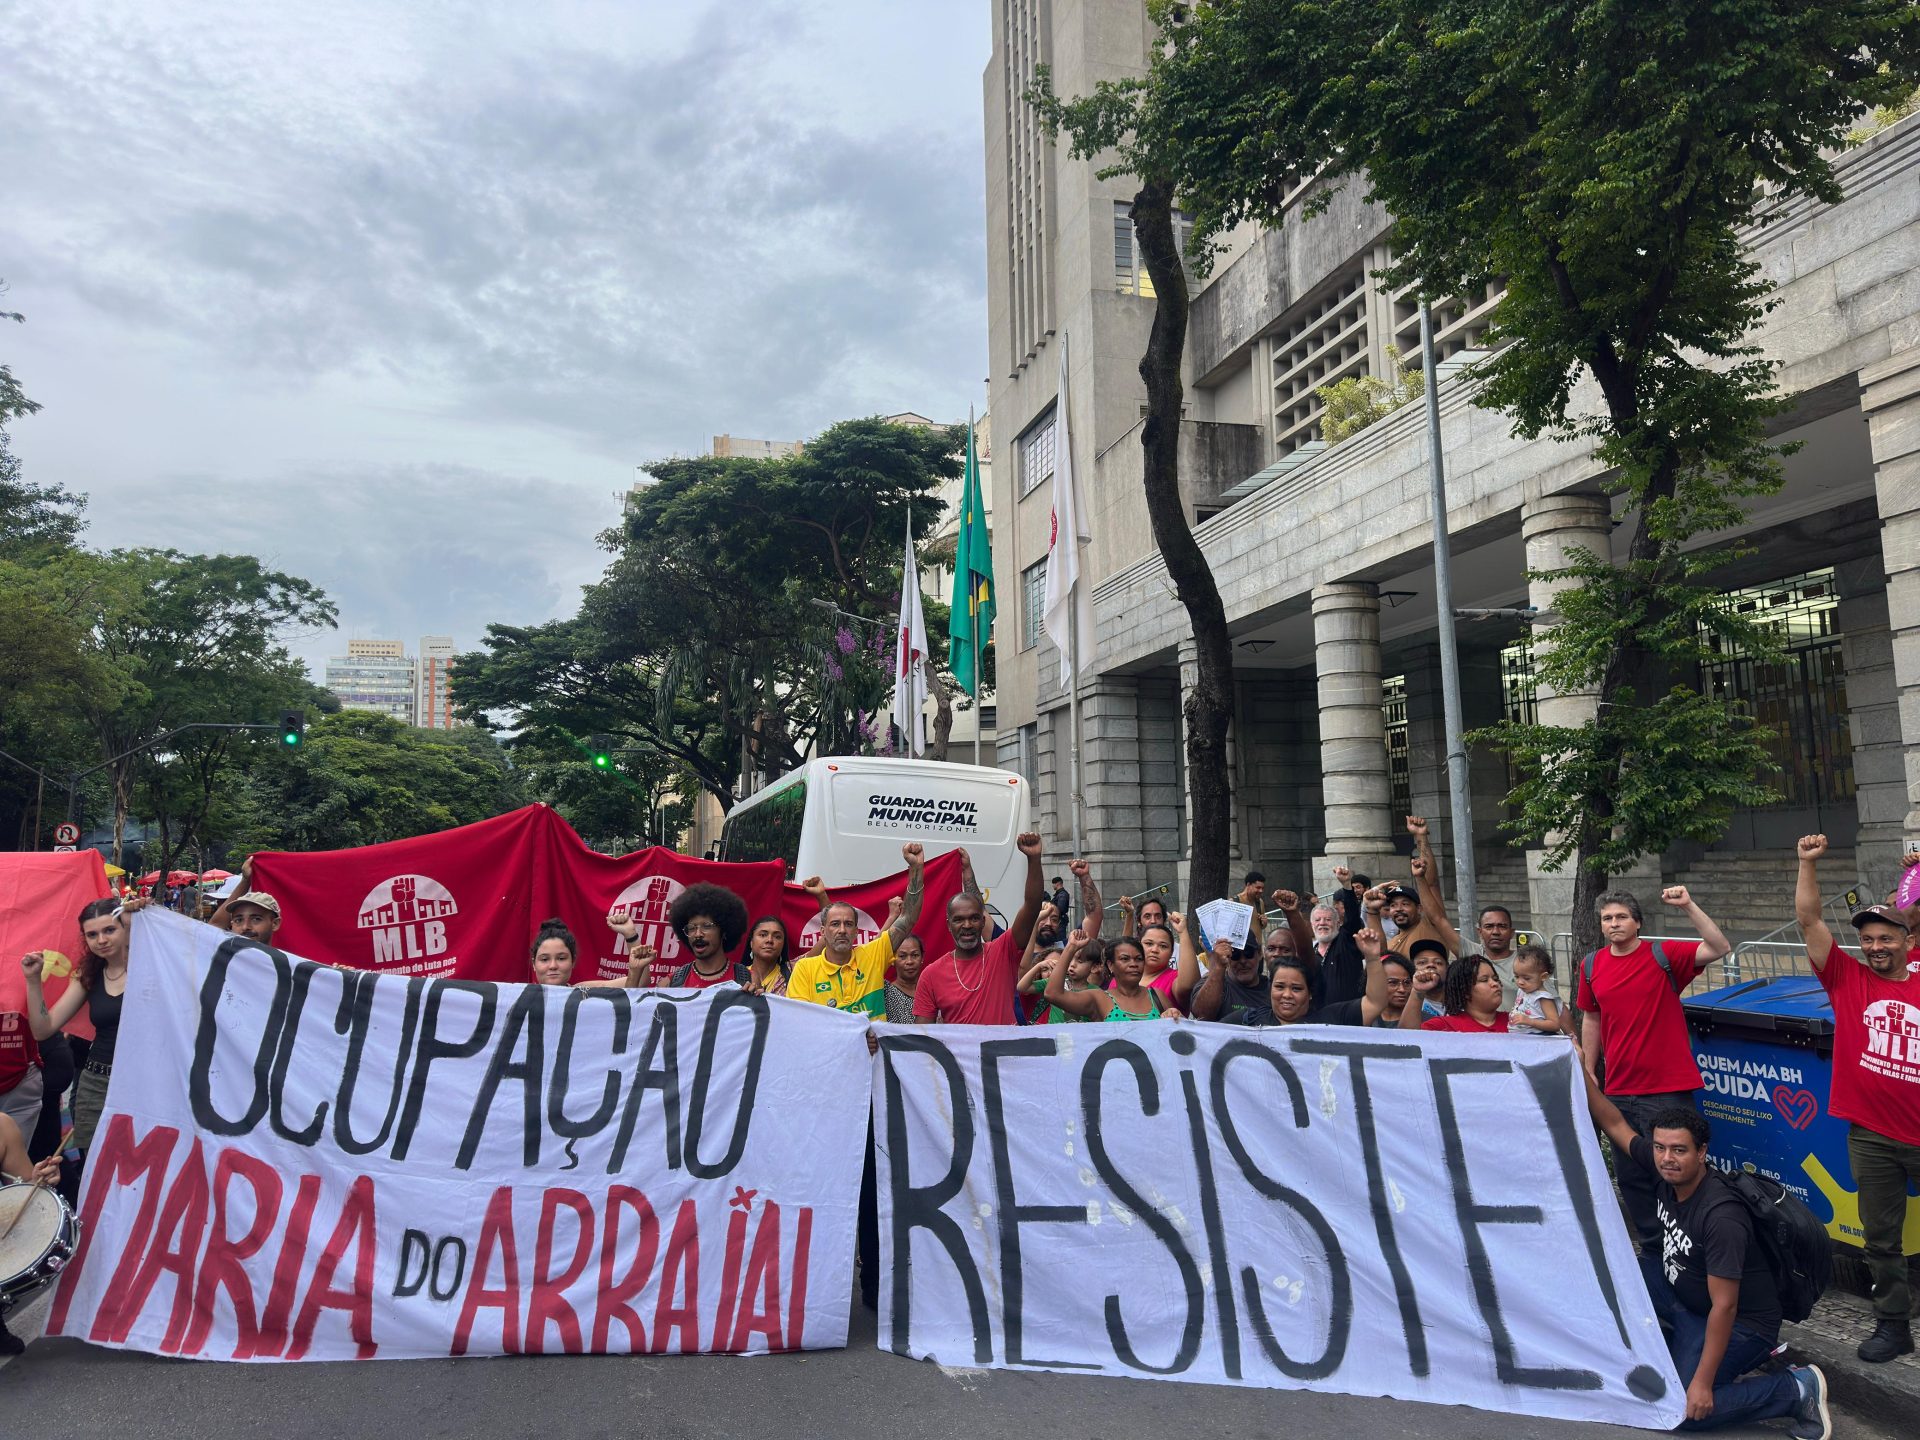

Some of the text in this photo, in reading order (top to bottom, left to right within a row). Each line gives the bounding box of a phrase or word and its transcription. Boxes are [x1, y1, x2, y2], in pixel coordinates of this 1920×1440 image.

[868, 795, 978, 812] GUARDA CIVIL
[867, 820, 978, 834] BELO HORIZONTE
[868, 807, 978, 826] MUNICIPAL
[1902, 868, 1918, 903] LIVRE
[372, 920, 448, 964] MLB
[412, 963, 423, 972] de
[424, 961, 442, 971] Luta
[442, 957, 457, 966] nos
[190, 938, 770, 1179] OCUPAÇÃO
[1696, 1053, 1803, 1085] QUEM AMA BH
[1901, 1066, 1917, 1075] LUTA
[1701, 1070, 1771, 1103] CUIDA
[1702, 1099, 1773, 1121] DESCARTE O SEU LIXO
[1761, 1168, 1781, 1181] BELO
[46, 1113, 377, 1360] MARIA
[394, 1228, 467, 1302] DO
